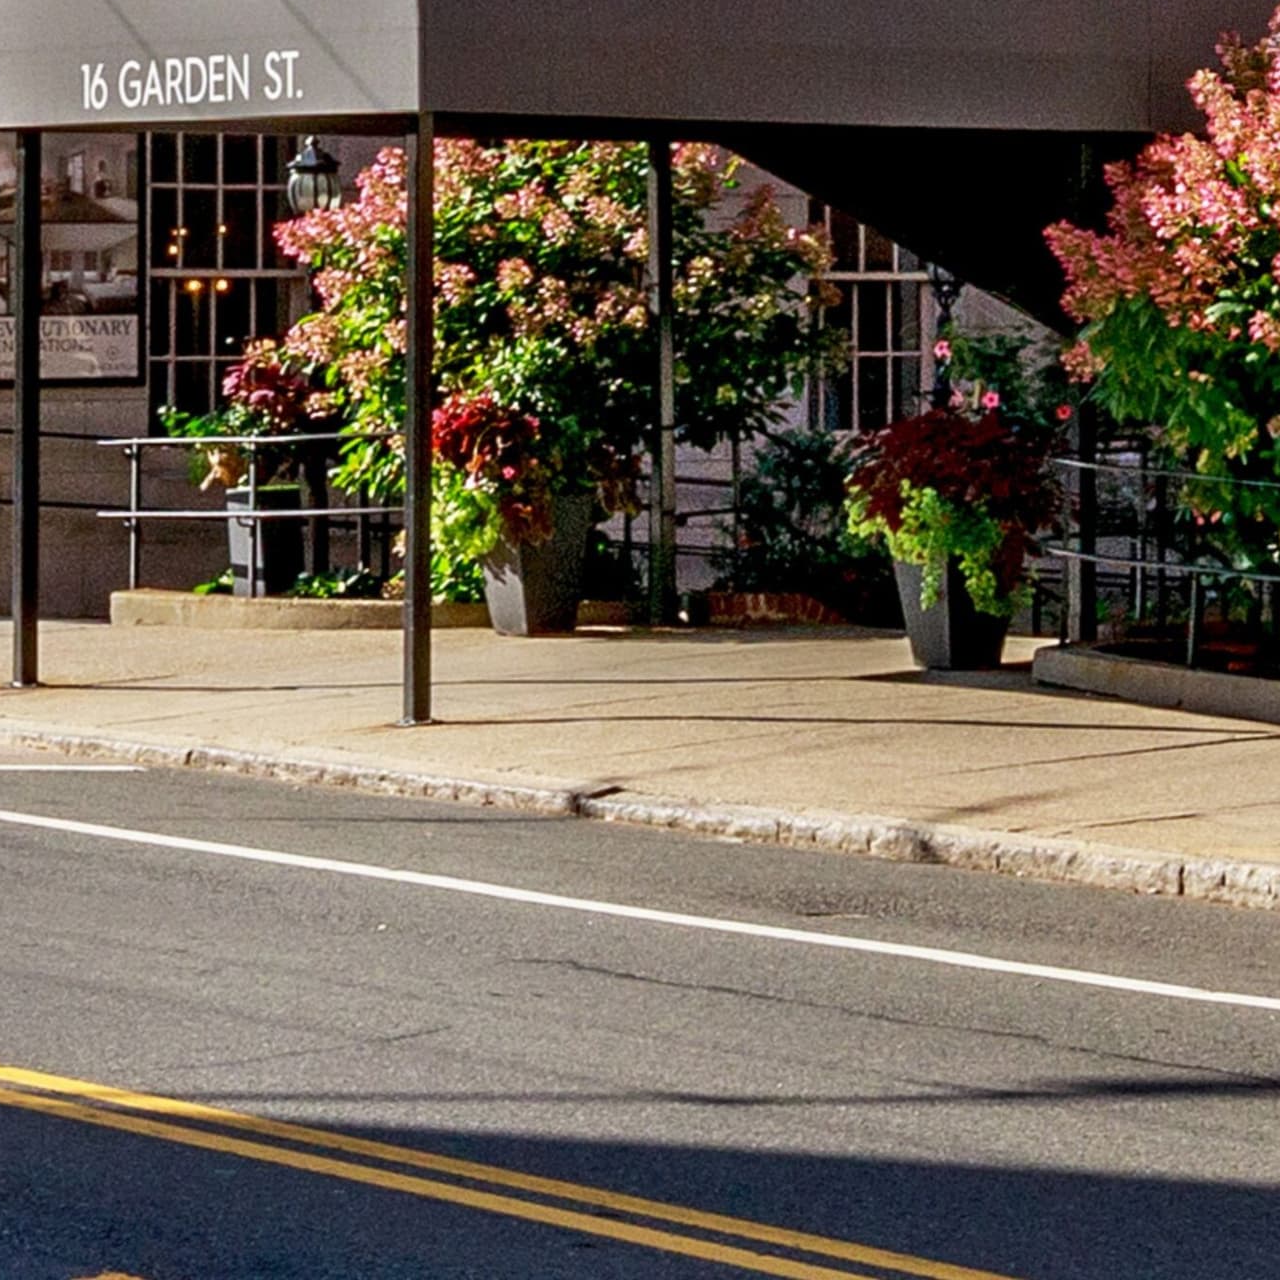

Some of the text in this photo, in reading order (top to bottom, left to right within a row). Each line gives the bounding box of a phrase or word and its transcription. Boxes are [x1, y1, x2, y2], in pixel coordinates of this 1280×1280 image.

[80, 51, 303, 109] 16 GARDEN ST.
